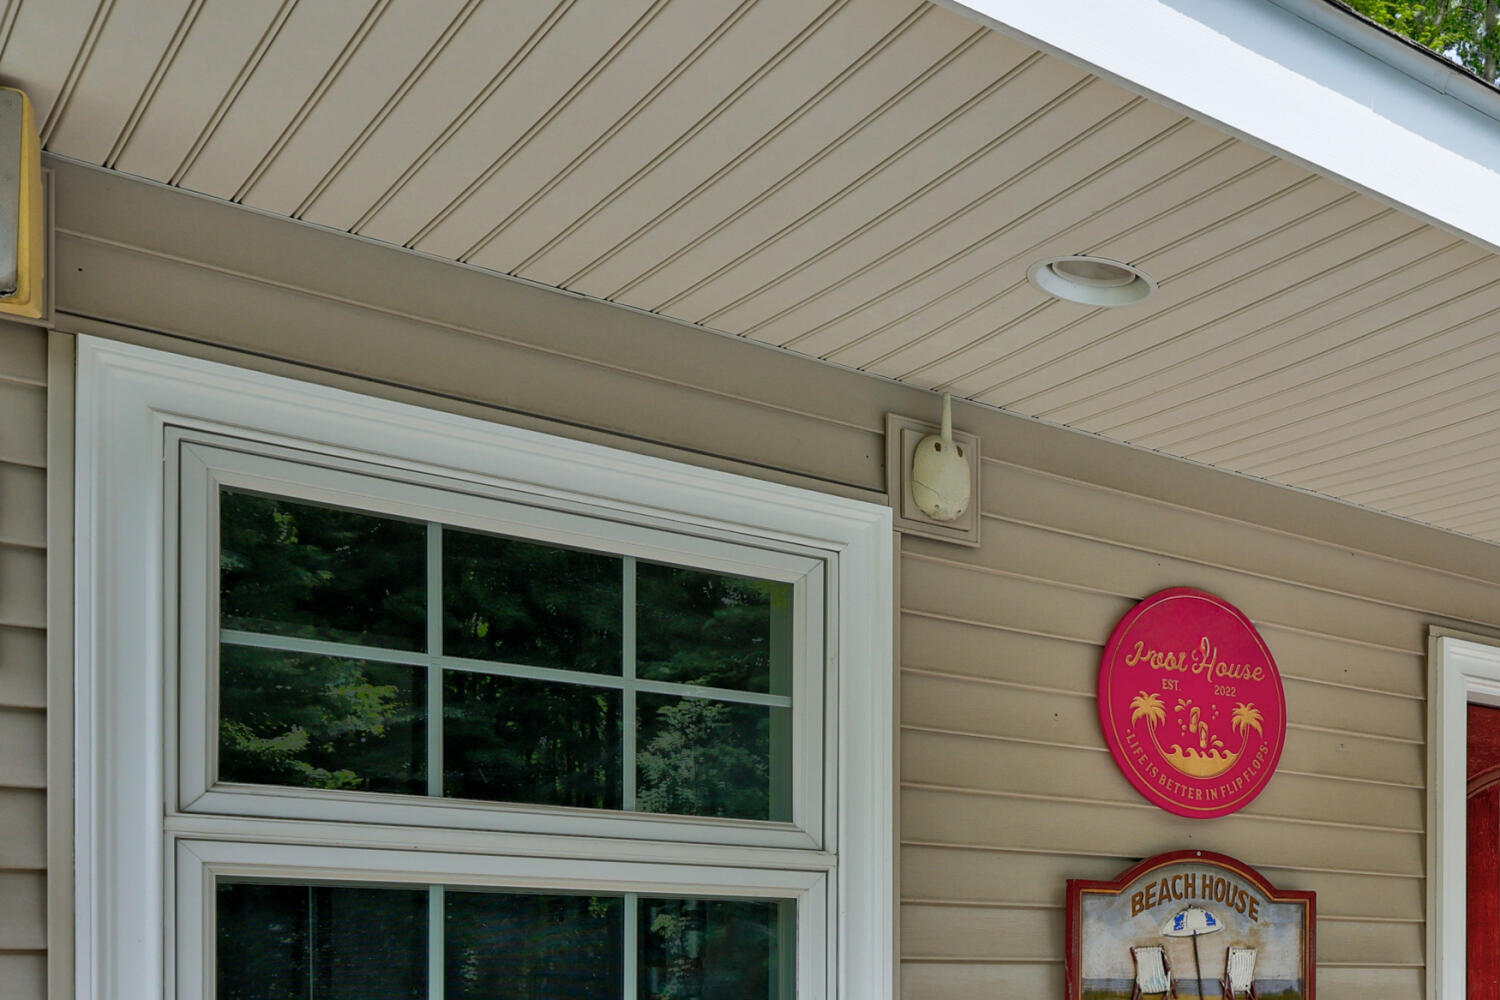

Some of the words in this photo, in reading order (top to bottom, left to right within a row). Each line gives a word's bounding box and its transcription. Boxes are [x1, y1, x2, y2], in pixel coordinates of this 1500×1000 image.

[1191, 636, 1265, 683] House
[1214, 684, 1237, 697] 2022
[1126, 732, 1150, 766] LIFE
[1145, 764, 1159, 779] IS
[1158, 774, 1203, 800] BETTER
[1205, 788, 1218, 800] IN
[1220, 778, 1244, 799] FLIP
[1243, 745, 1269, 784] FLOPS
[1131, 872, 1196, 918] BEACH
[1201, 873, 1260, 923] HOUSE
